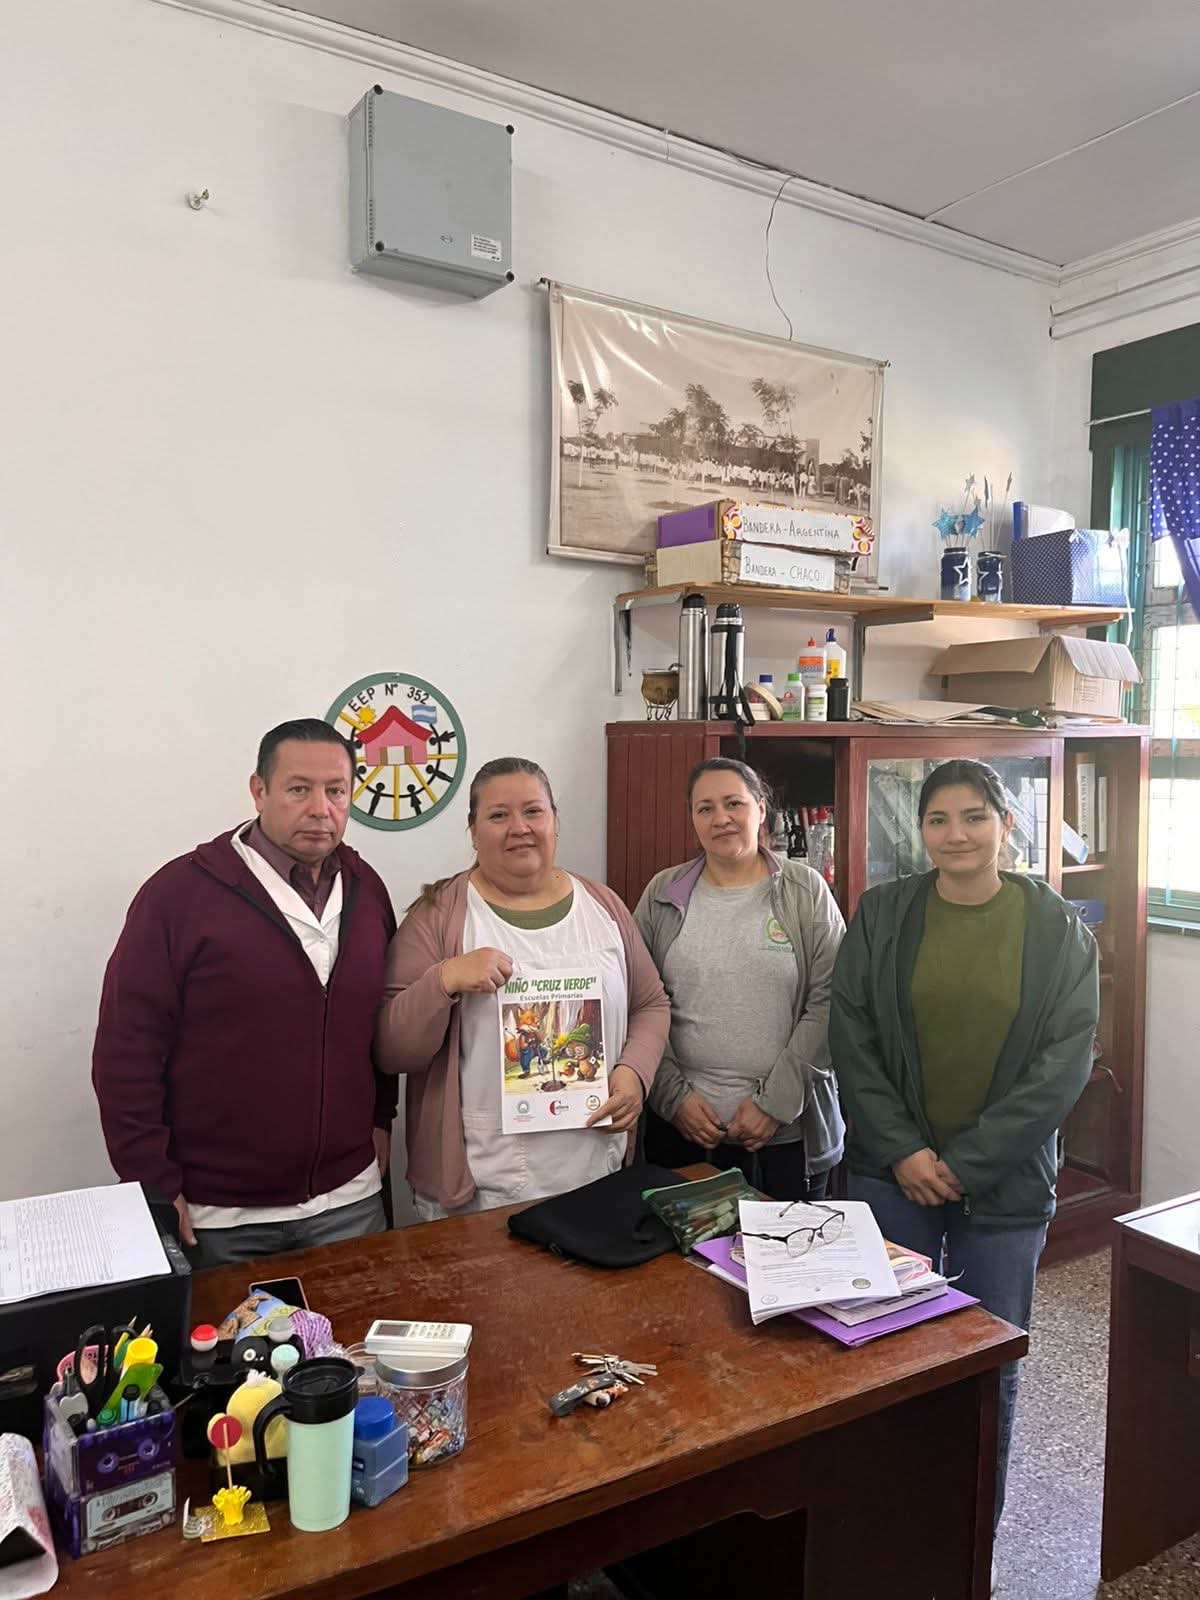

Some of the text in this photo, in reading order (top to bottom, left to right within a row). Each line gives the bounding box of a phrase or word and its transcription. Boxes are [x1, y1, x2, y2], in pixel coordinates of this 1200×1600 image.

[789, 565, 821, 581] CHACO
[348, 687, 375, 712] EEP
[407, 686, 430, 705] 352
[504, 976, 596, 994] NIÑO "CRUZ VERDE"
[520, 993, 549, 1001] Escuelas
